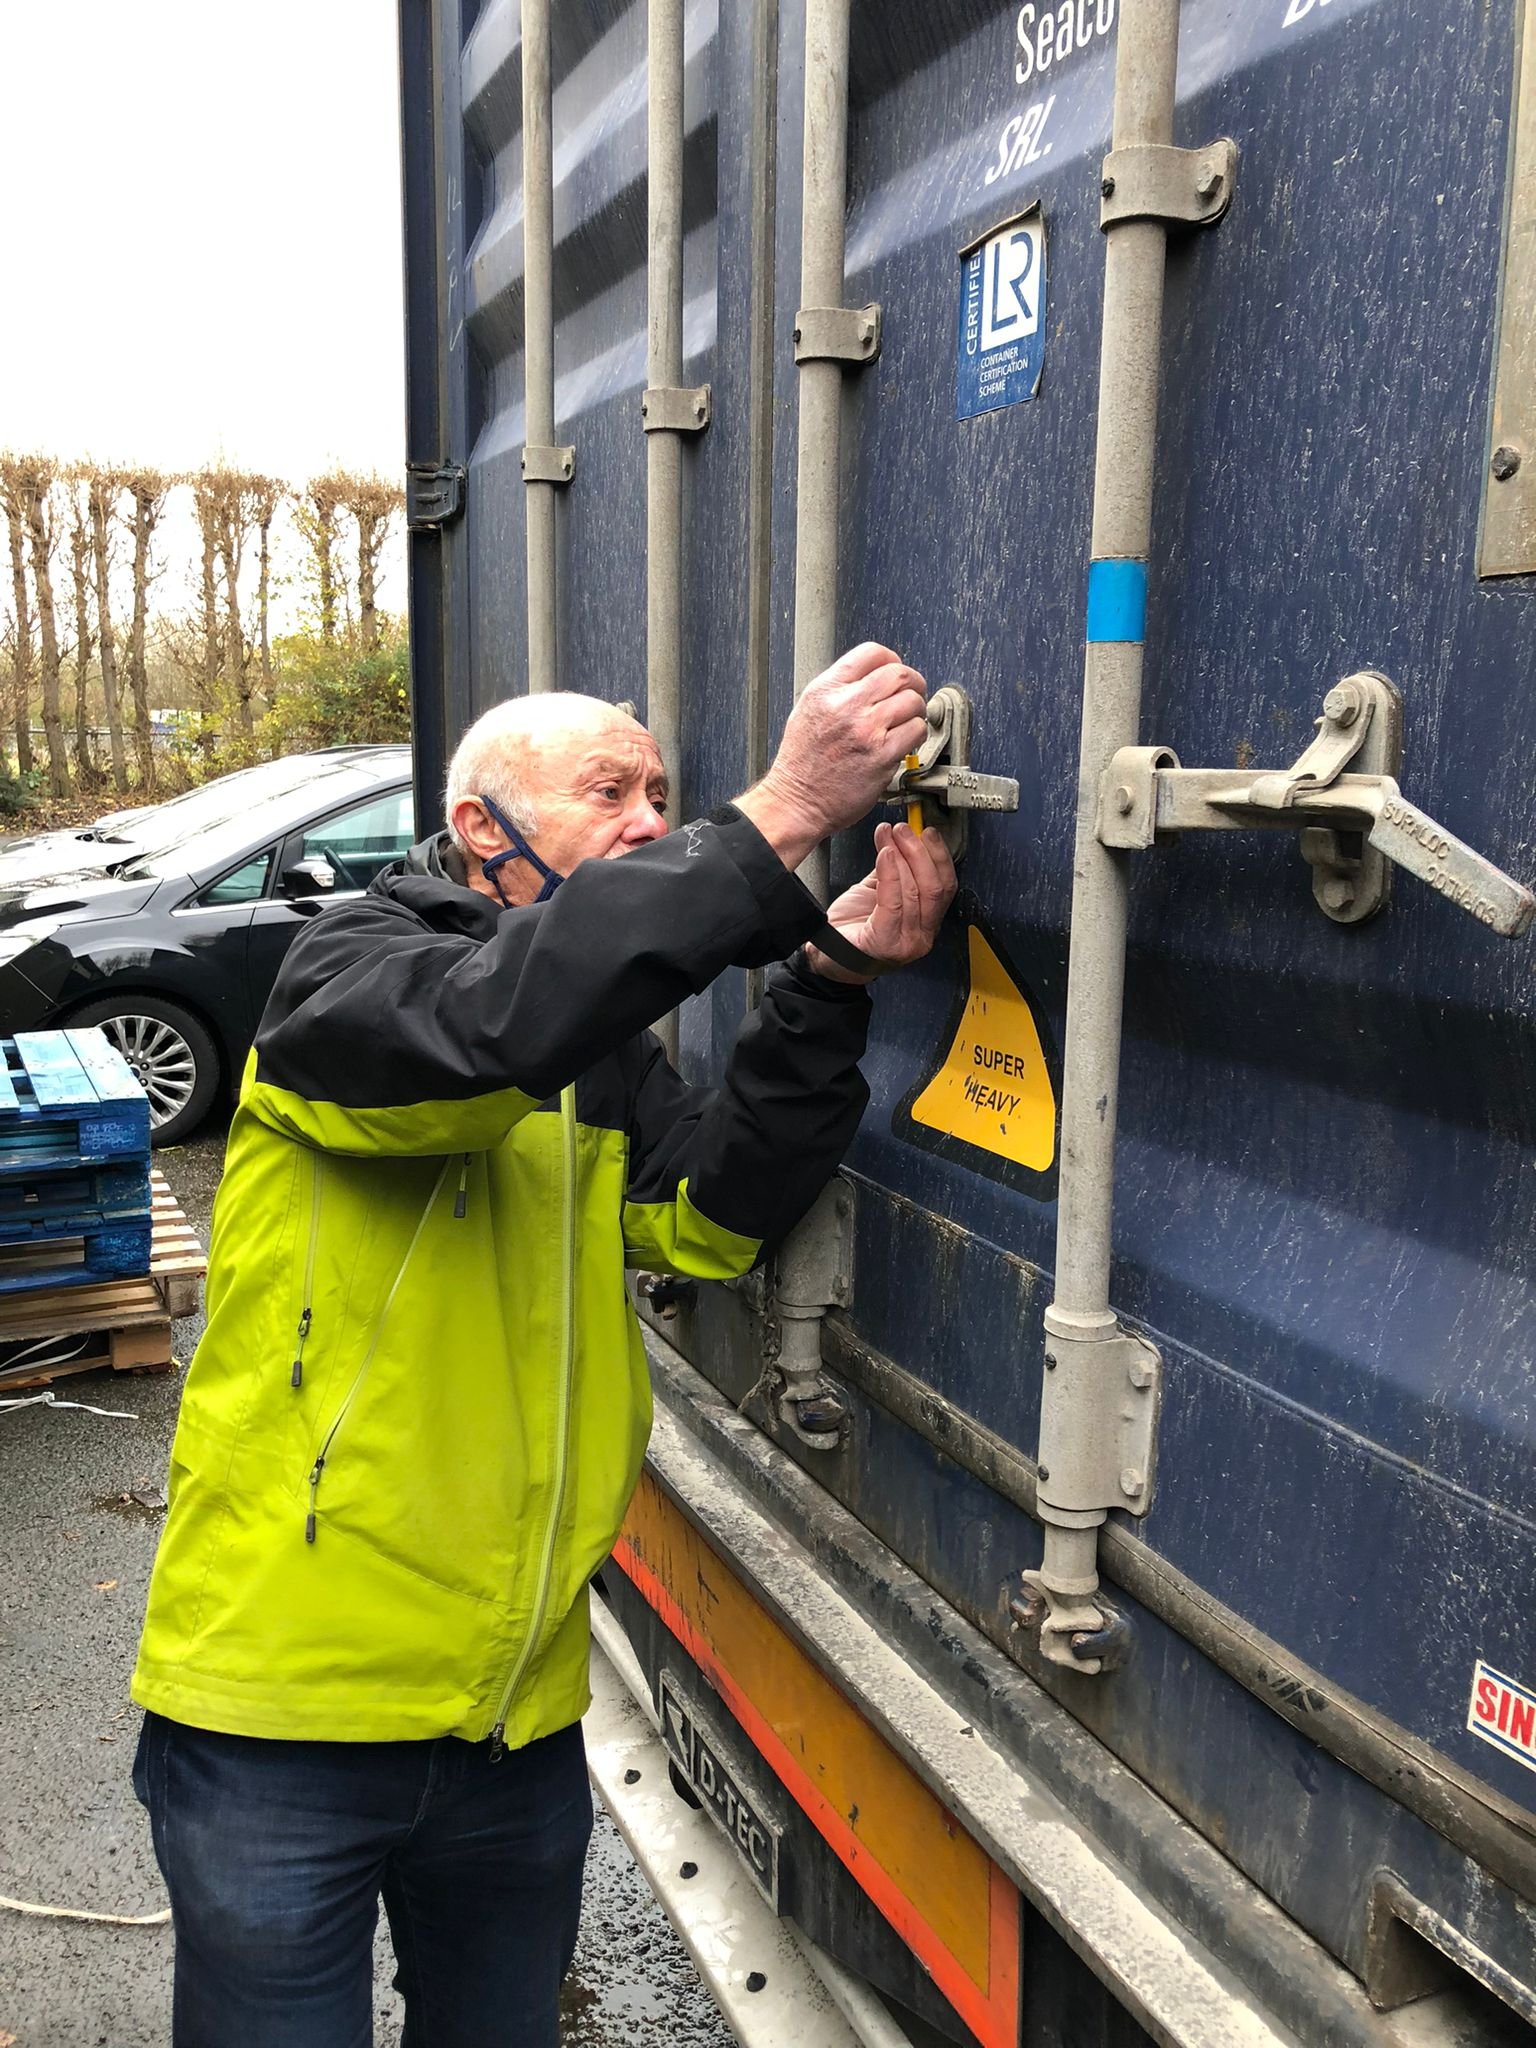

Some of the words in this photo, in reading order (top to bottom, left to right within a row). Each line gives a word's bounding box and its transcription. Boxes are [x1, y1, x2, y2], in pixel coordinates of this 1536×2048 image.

[985, 94, 1056, 186] SRL.
[979, 357, 1029, 383] CERTIFICATION
[980, 346, 1019, 369] CONTAINER
[978, 378, 1006, 398] SCHEME
[973, 1044, 1025, 1080] SUPER
[964, 1080, 1021, 1117] HEAVY
[1475, 1678, 1536, 1749] SIN
[700, 1749, 766, 1872] D-TEC
